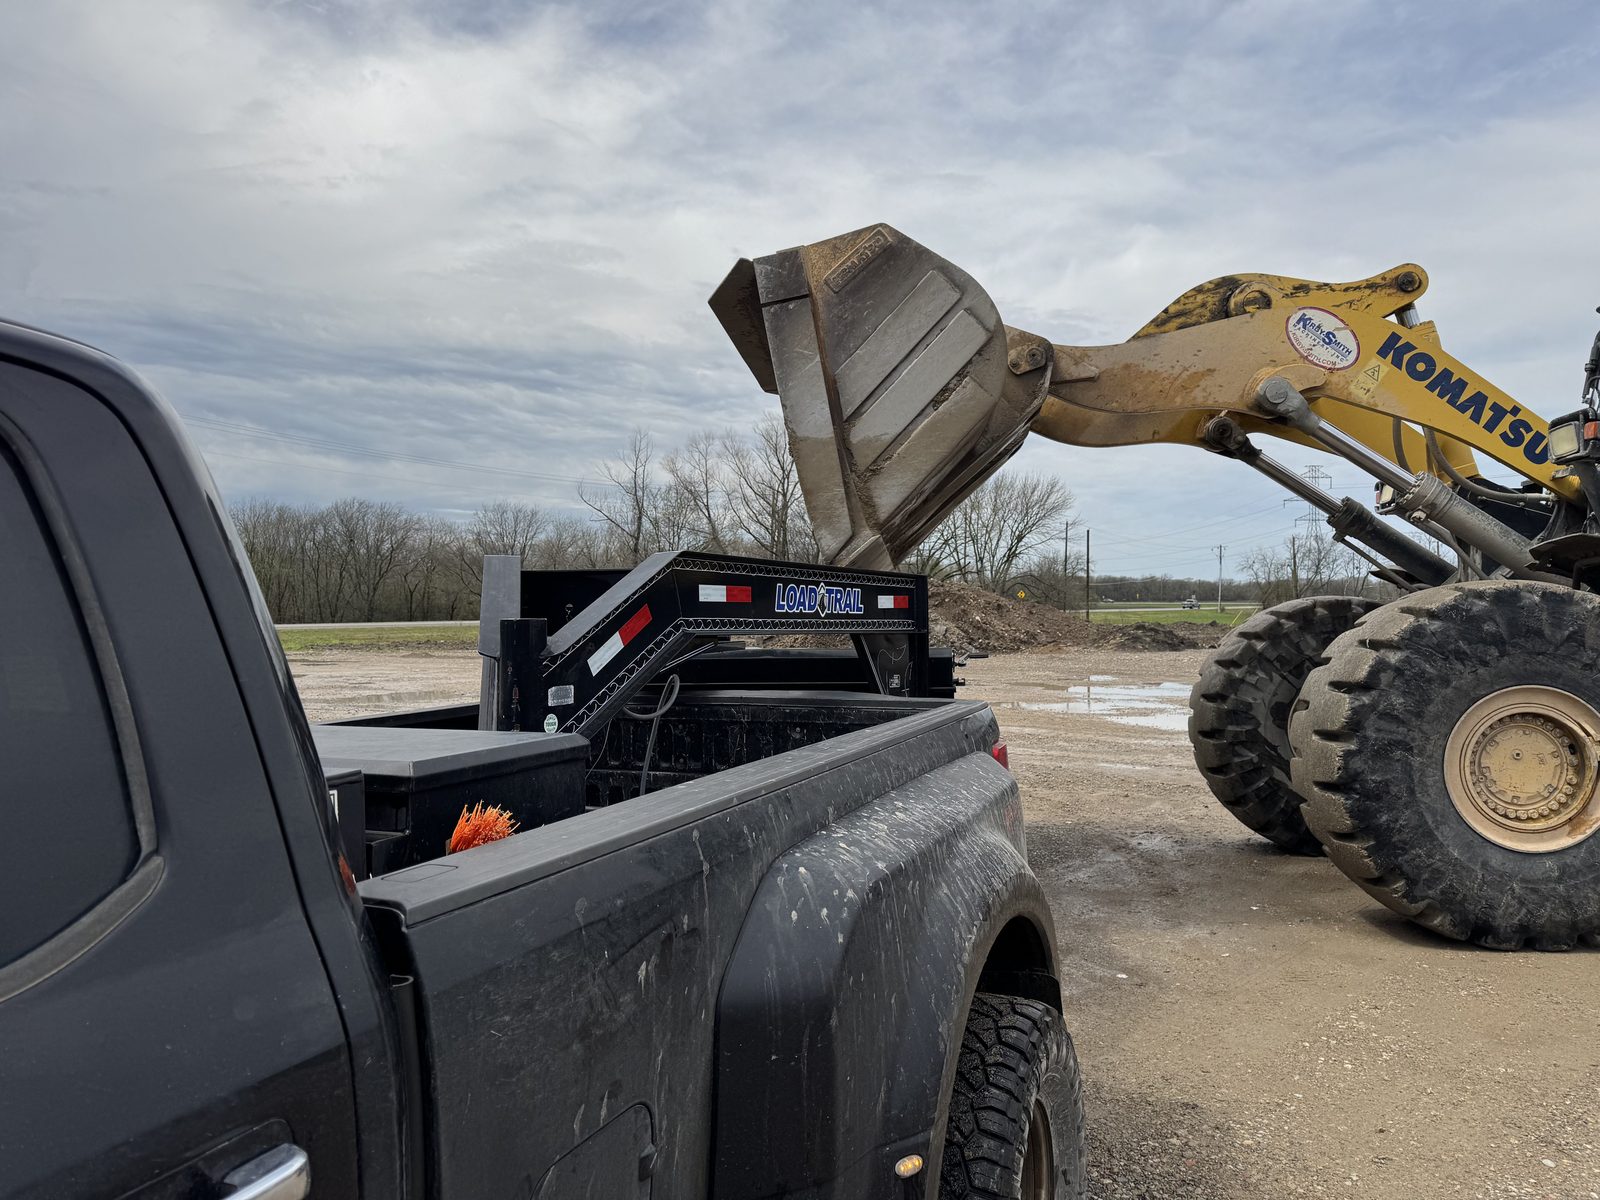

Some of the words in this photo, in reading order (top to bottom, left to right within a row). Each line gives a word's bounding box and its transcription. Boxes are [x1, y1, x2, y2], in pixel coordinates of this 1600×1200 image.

[1376, 331, 1549, 465] KOMATSU
[775, 583, 818, 612] LOAD
[825, 587, 864, 614] TRAIL
